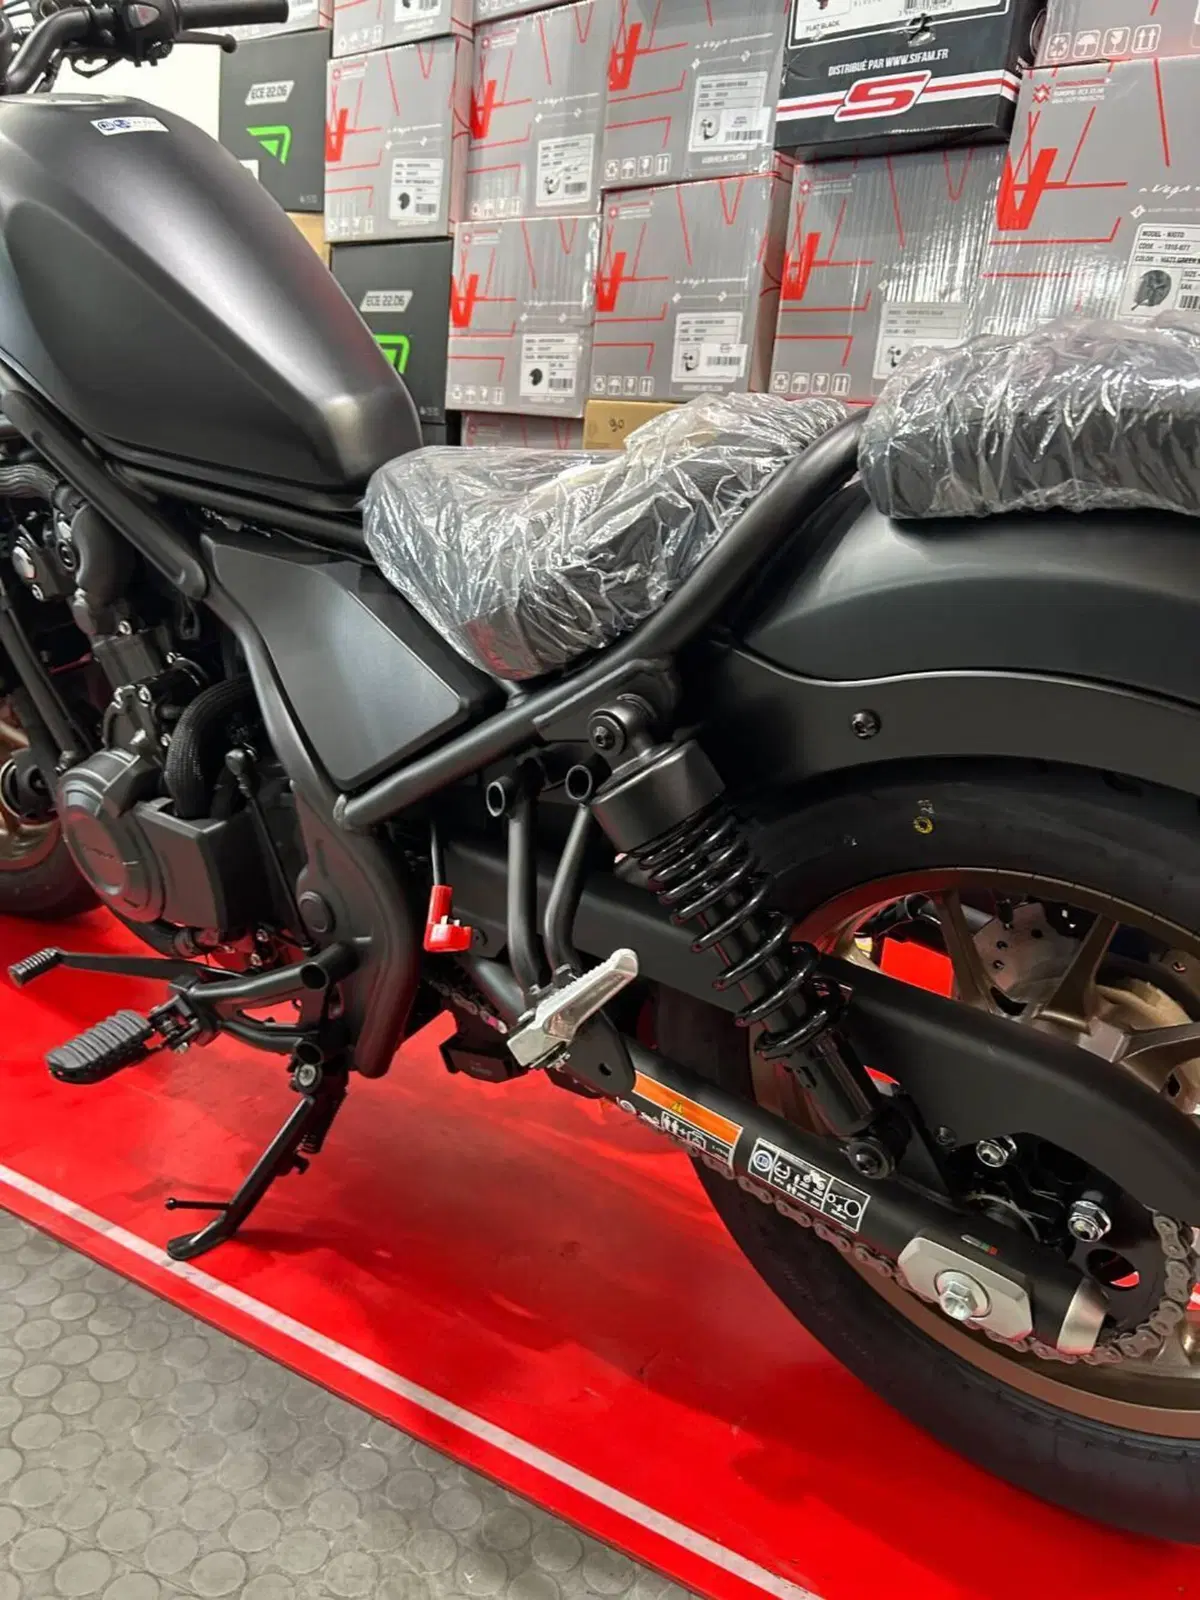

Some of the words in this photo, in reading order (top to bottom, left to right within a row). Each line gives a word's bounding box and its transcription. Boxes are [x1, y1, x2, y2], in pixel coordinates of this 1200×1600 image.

[828, 59, 867, 76] DISTRIBUÉ
[868, 58, 885, 70] PAR
[885, 48, 949, 68] WWW.SIFAM.FR
